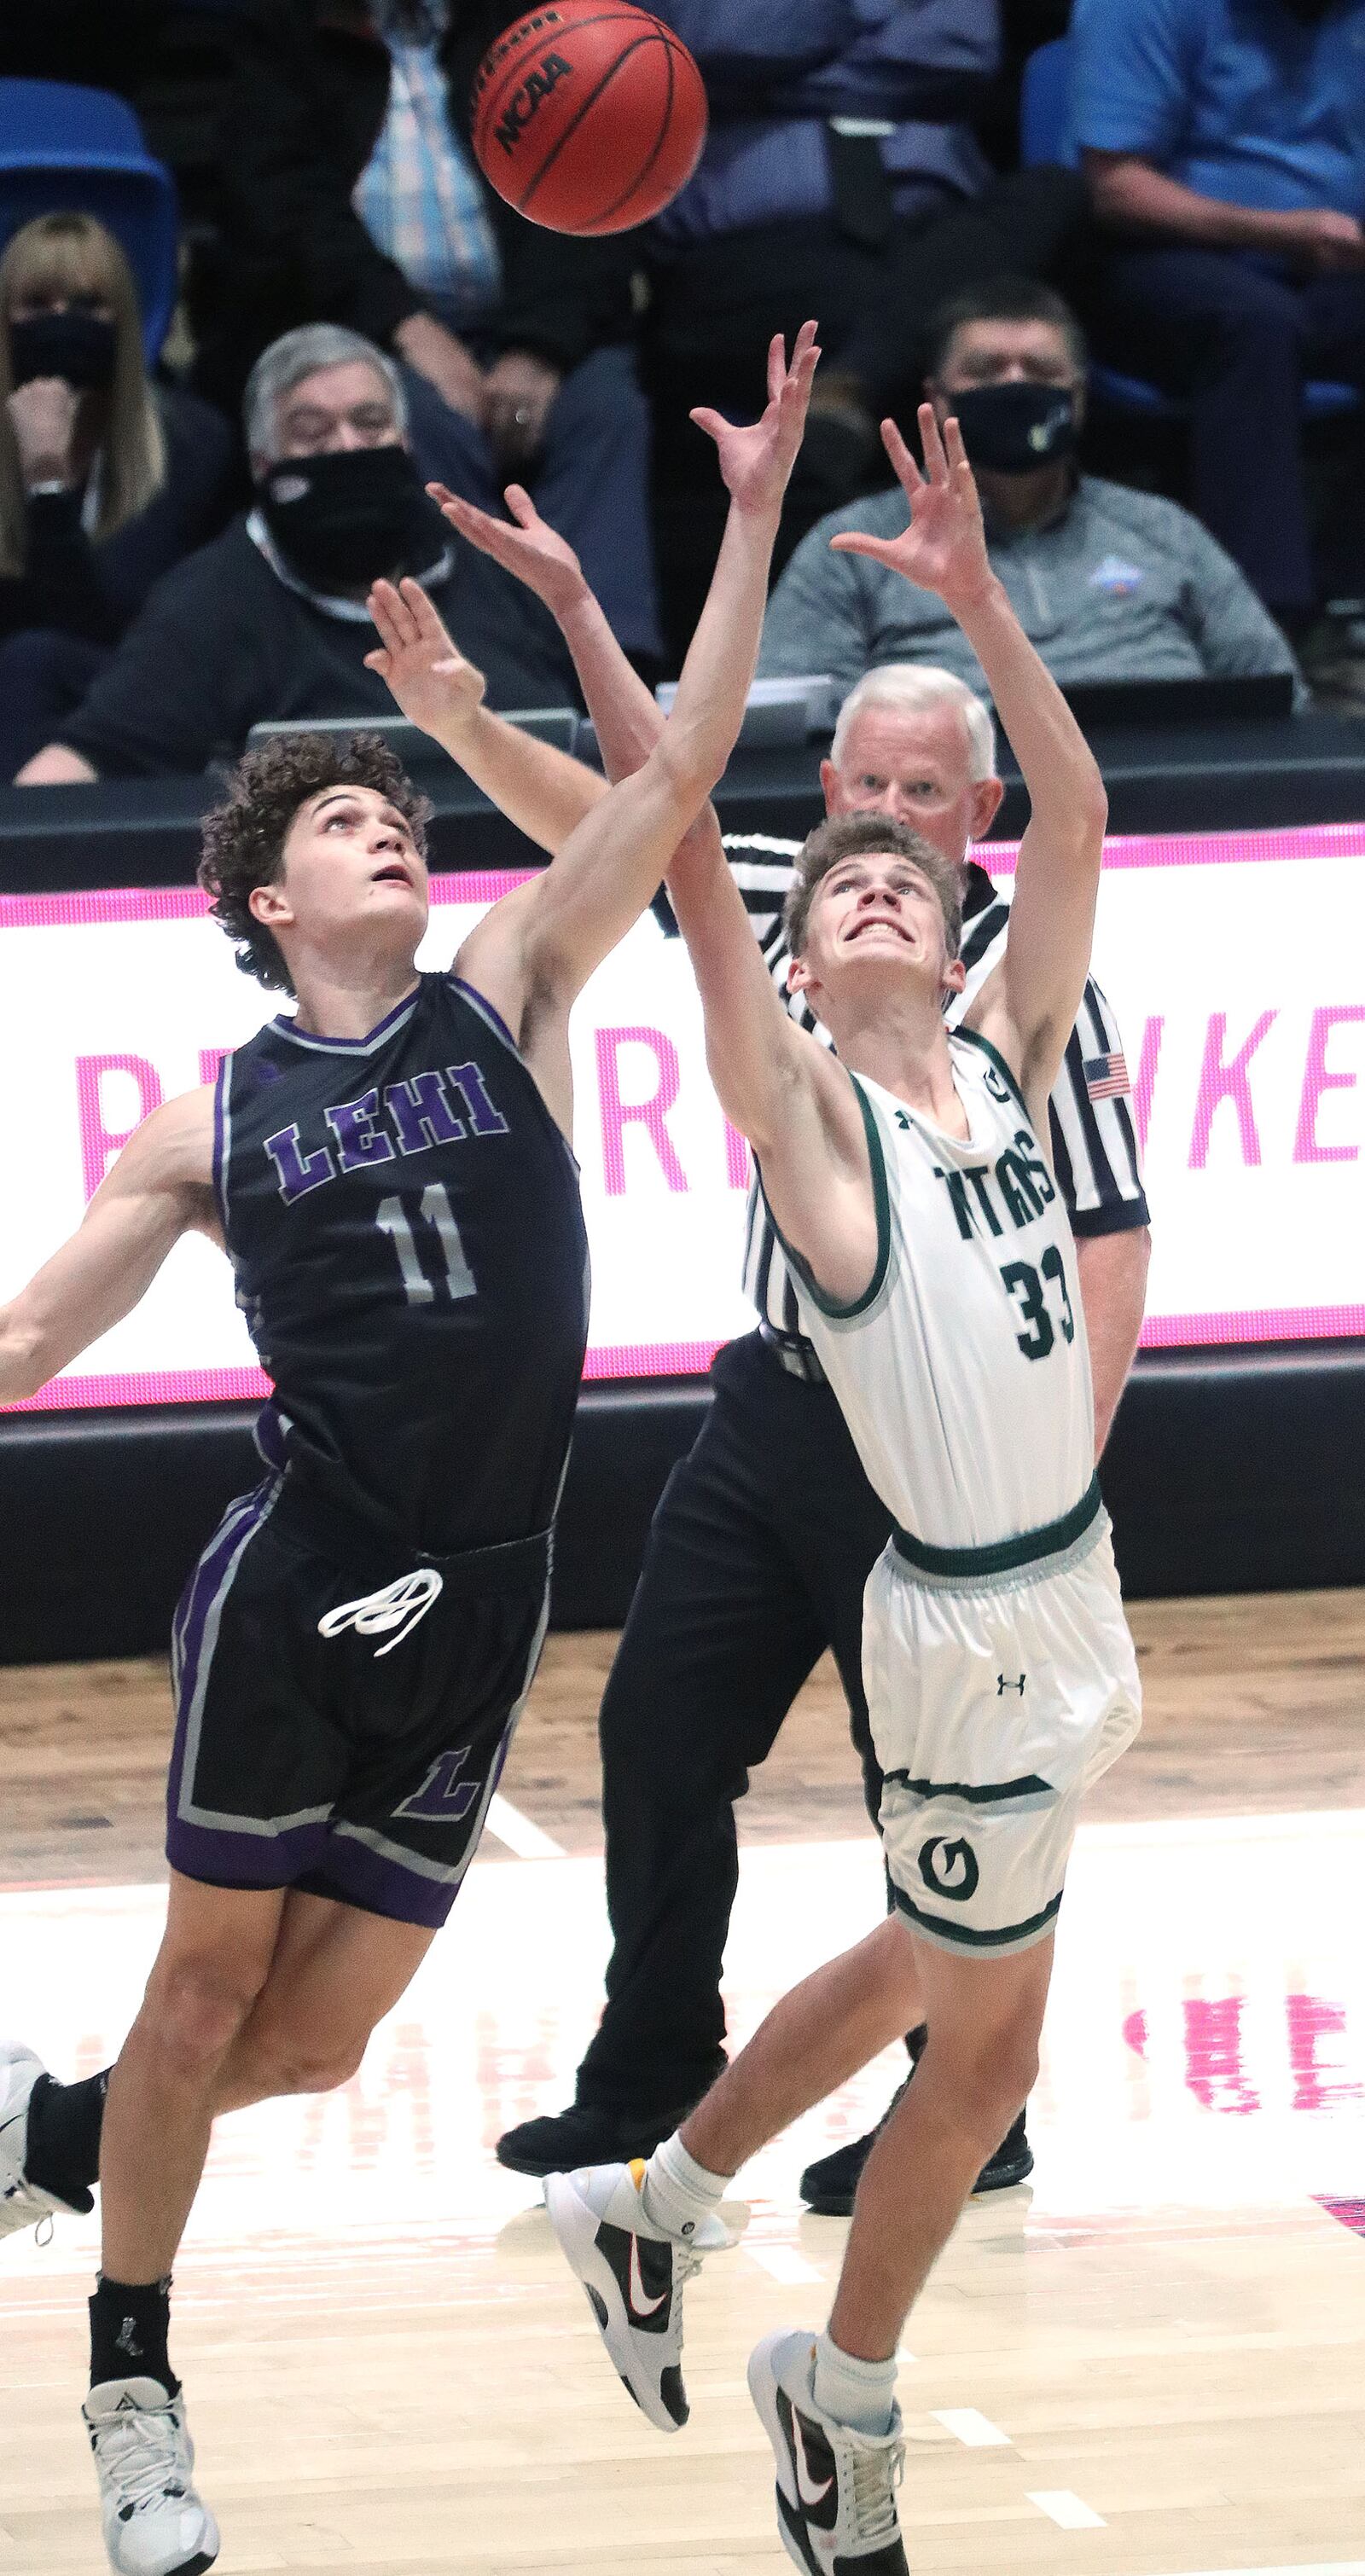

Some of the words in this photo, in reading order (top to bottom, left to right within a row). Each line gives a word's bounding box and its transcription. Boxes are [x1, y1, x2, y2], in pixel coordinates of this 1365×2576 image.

[494, 52, 574, 156] NCAA
[263, 1062, 510, 1206] LEHI
[375, 1183, 478, 1303] 11
[999, 1243, 1075, 1361] 33
[390, 1745, 481, 1822] L
